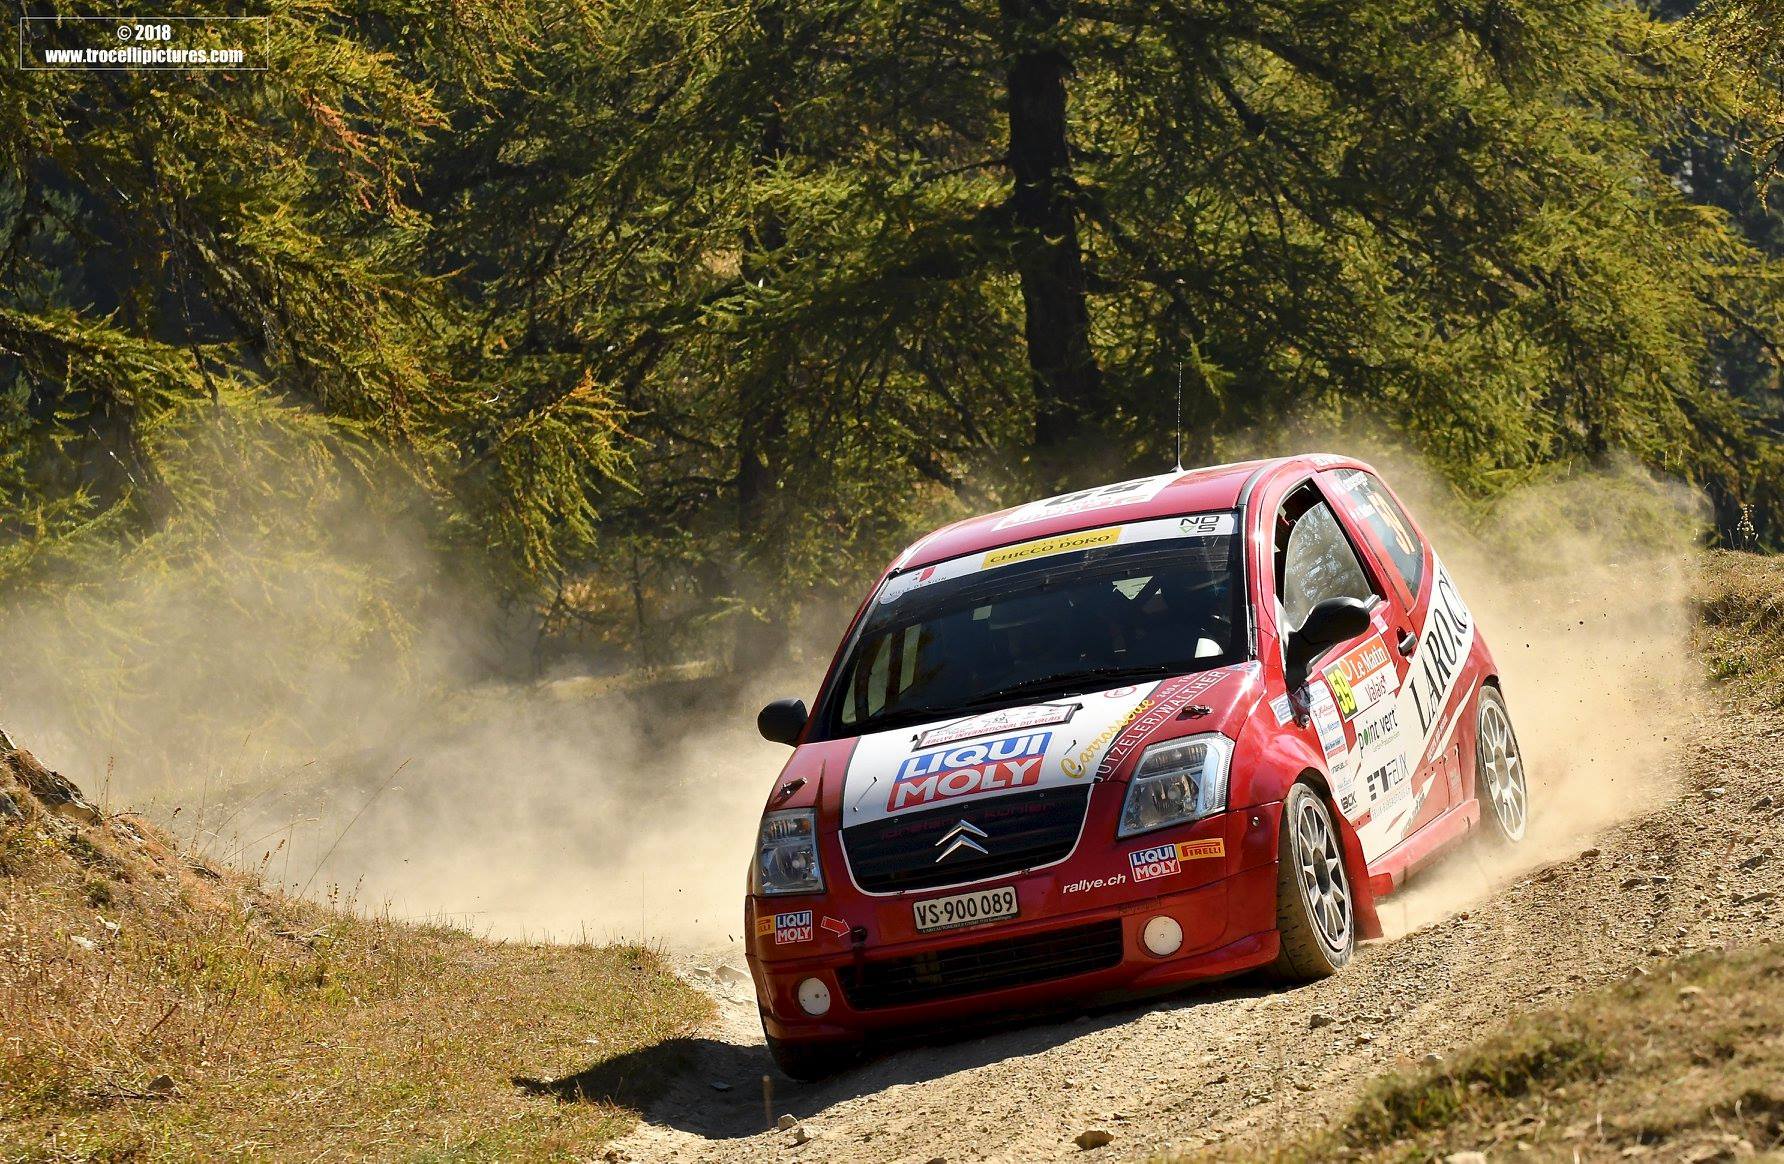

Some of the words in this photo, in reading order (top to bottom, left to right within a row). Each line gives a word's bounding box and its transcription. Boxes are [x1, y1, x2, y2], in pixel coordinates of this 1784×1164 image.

[989, 545, 1054, 563] CHICCO
[1349, 659, 1367, 679] Le
[1359, 645, 1388, 673] Matin
[1327, 668, 1356, 715] 59
[955, 722, 1017, 739] INTERNATIONAL
[1019, 719, 1033, 727] DU
[1379, 709, 1398, 735] vert
[902, 733, 1047, 780] LIQUI
[894, 757, 1043, 809] MOLY
[1132, 846, 1174, 866] LIQUI
[1181, 841, 1221, 857] PIRELLI
[1134, 859, 1177, 880] MOLY
[1062, 873, 1127, 893] rallye.ch
[980, 891, 1014, 915] 089
[777, 912, 810, 929] LIQUI
[777, 926, 811, 943] MOLY
